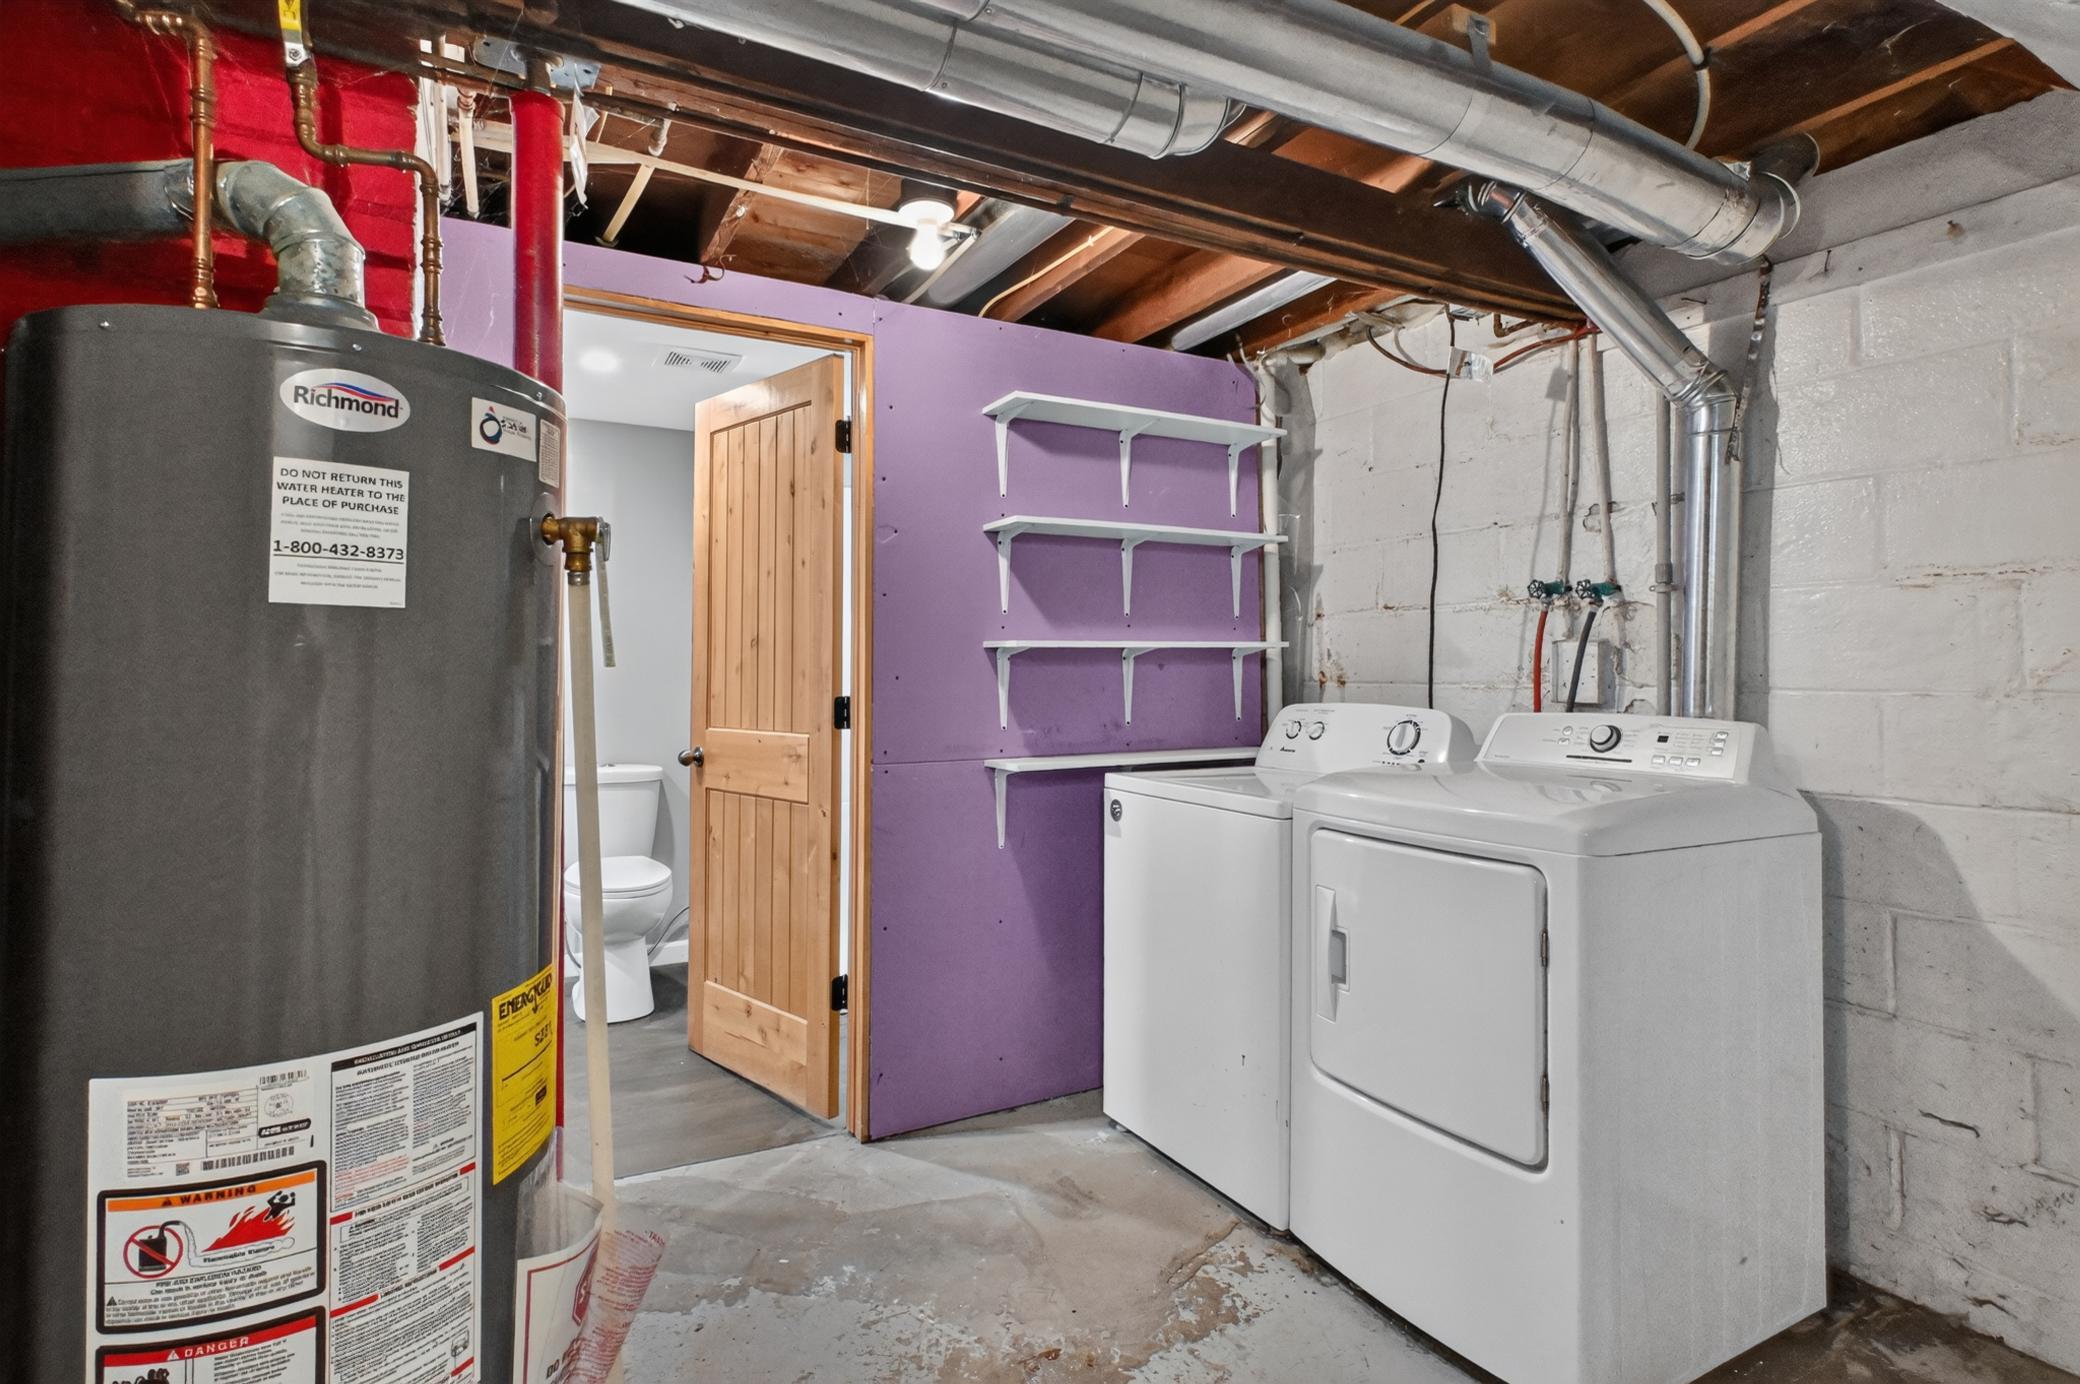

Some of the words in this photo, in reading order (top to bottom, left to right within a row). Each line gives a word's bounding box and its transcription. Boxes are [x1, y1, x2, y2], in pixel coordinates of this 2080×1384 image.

[294, 385, 399, 419] Richmond
[280, 468, 298, 478] DO
[302, 470, 327, 480] NOT
[331, 473, 376, 486] RETURN
[380, 478, 403, 489] THIS
[277, 482, 317, 493] WATER
[321, 486, 364, 498] HEATER
[368, 491, 382, 500] TO
[386, 492, 405, 502] THE
[282, 496, 318, 507] PLACE
[322, 499, 338, 509] OF
[341, 501, 399, 515] PURCHASE
[273, 540, 404, 560] 1-800-432-8373
[180, 1184, 256, 1204] WARNING
[184, 1337, 249, 1357] DANGER
